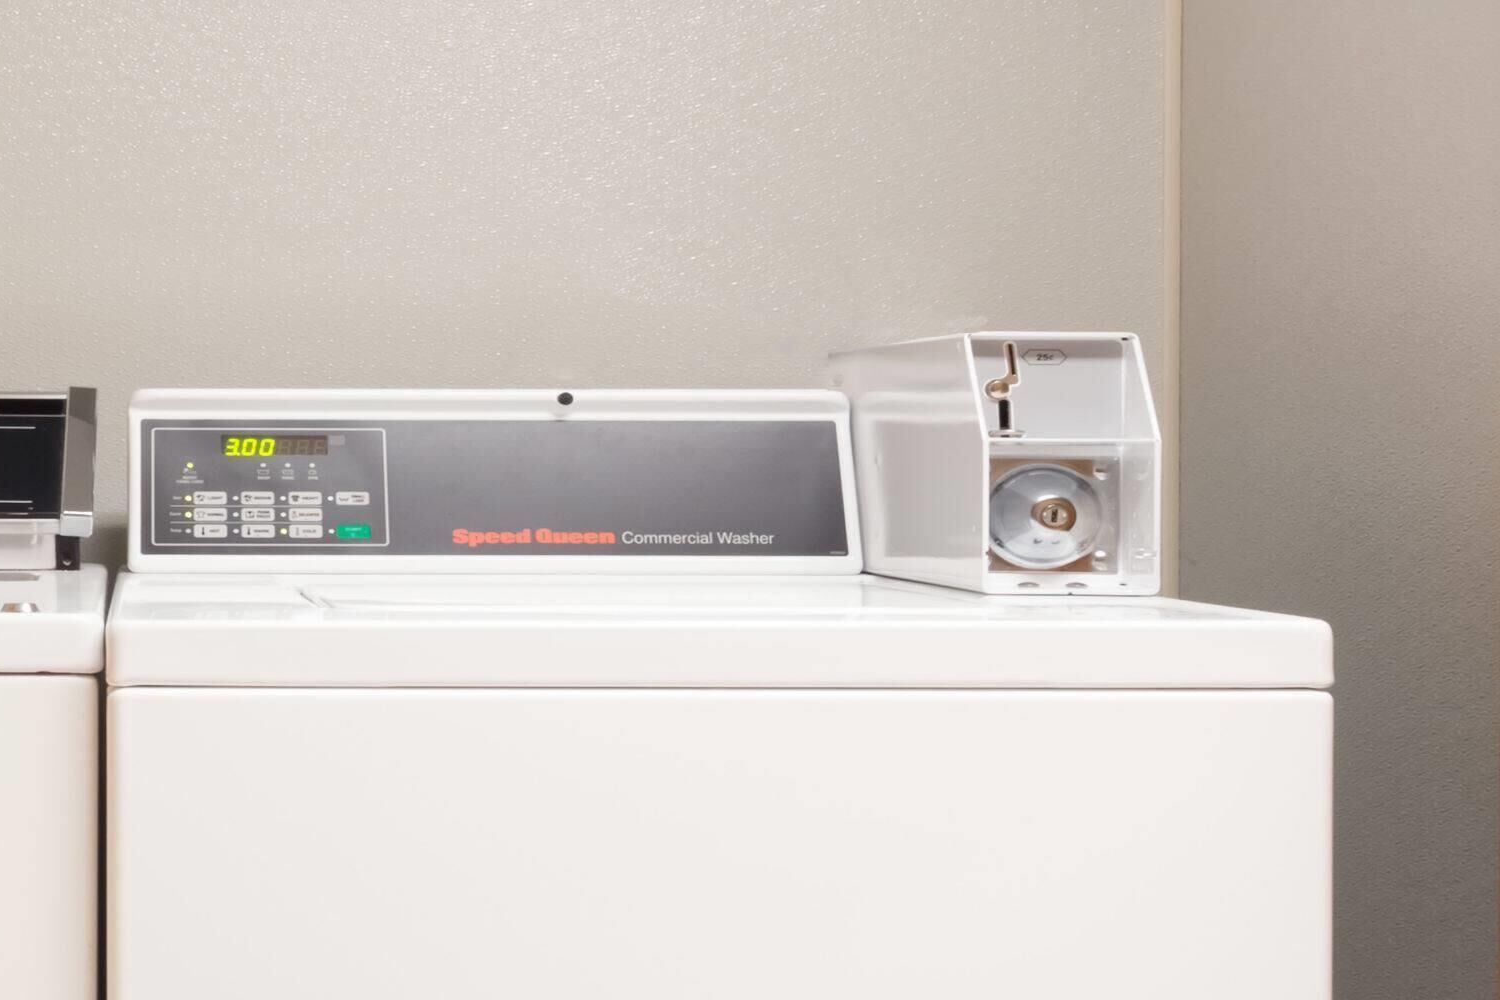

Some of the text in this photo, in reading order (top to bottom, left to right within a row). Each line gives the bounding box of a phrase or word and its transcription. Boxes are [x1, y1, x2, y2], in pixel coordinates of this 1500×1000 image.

[452, 528, 775, 546] Speed Queen Commercial Washer
